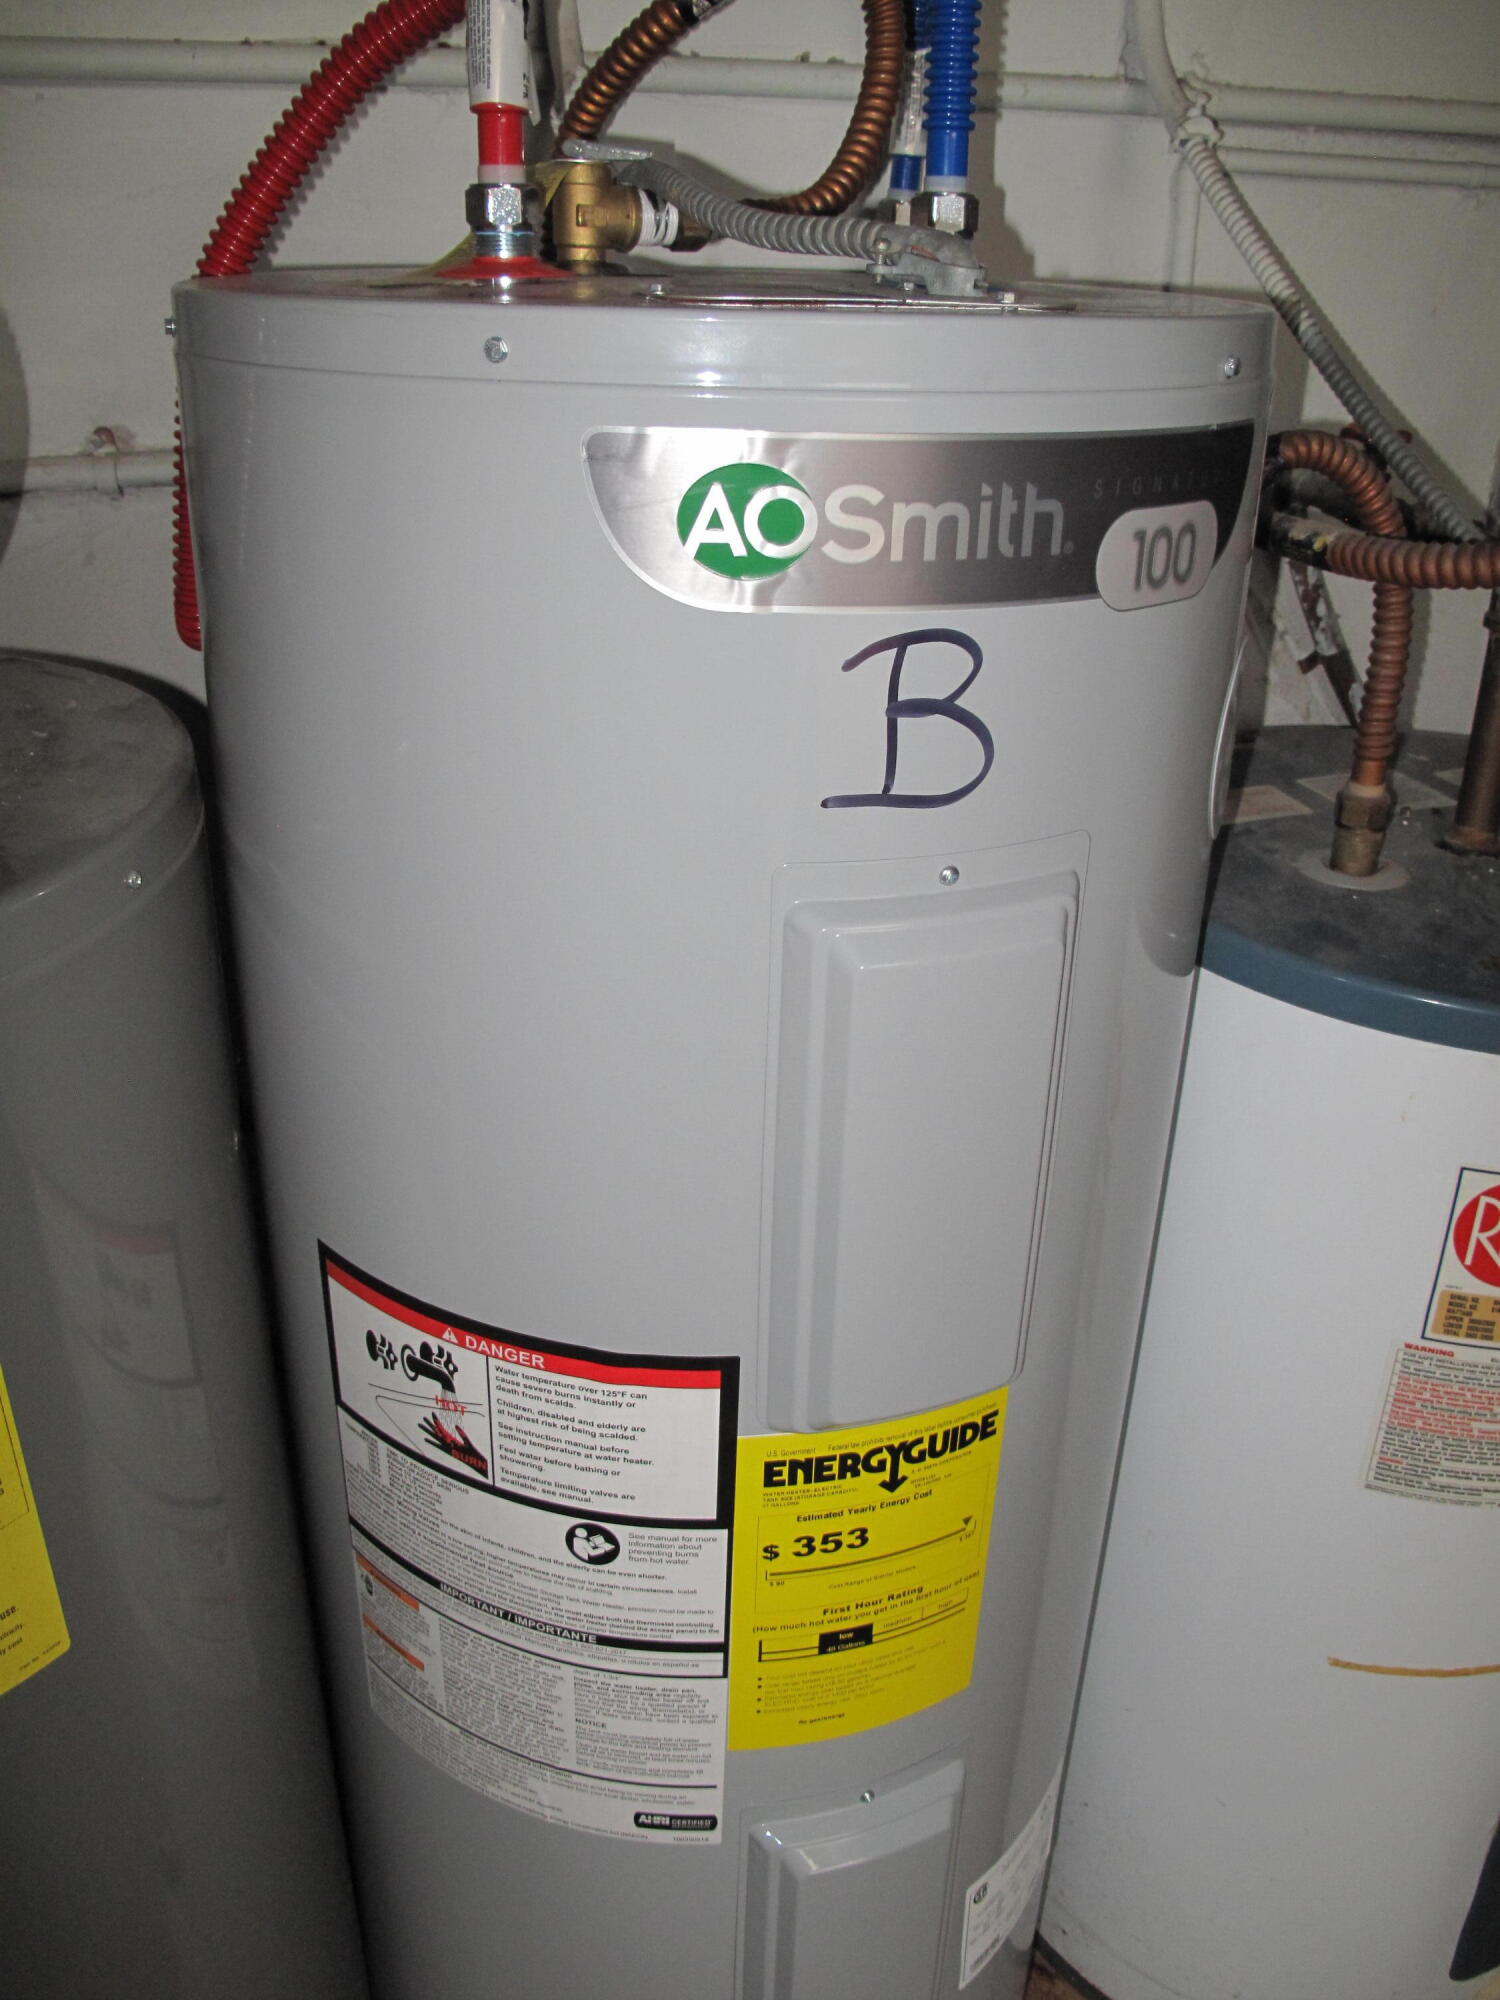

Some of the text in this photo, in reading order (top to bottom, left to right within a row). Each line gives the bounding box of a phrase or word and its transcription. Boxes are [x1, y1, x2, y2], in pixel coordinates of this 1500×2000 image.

[1133, 523, 1197, 594] 100
[820, 628, 994, 808] B
[465, 1333, 546, 1369] DANGER
[1404, 1342, 1454, 1358] WARNING
[495, 1365, 519, 1377] Water
[522, 1372, 575, 1390] temperature
[579, 1385, 602, 1395] over
[602, 1389, 627, 1398] 125°F
[496, 1377, 521, 1387] cause
[523, 1383, 552, 1395] severe
[555, 1388, 581, 1400] burns
[584, 1395, 624, 1408] instantly
[496, 1385, 576, 1409] death from scalds.
[435, 1394, 467, 1417] HOT
[497, 1398, 535, 1415] Children,
[538, 1409, 575, 1423] disabled
[578, 1418, 594, 1427] and
[597, 1421, 624, 1433] elderly
[498, 1421, 629, 1454] See instruction manual before
[507, 1410, 539, 1425] highest
[541, 1418, 557, 1428] risk
[572, 1425, 597, 1438] being
[599, 1430, 637, 1441] scalded.
[451, 1446, 488, 1470] BURN
[498, 1432, 527, 1445] setting
[529, 1440, 582, 1456] temperature
[595, 1454, 620, 1463] water
[623, 1457, 654, 1466] heater.
[499, 1444, 516, 1454] Feel
[519, 1452, 541, 1461] water
[544, 1456, 572, 1468] before
[574, 1463, 608, 1476] bathing
[500, 1454, 545, 1472] showering.
[764, 1409, 999, 1492] ENERGYGUIDE
[780, 1447, 816, 1457] Government
[828, 1443, 848, 1451] Federal
[500, 1467, 552, 1486] Temperature
[554, 1481, 587, 1495] limiting
[590, 1488, 618, 1500] valves
[501, 1476, 593, 1504] available, see manual.
[797, 1489, 933, 1523] Estimated Yearly Energy Cost
[628, 1532, 645, 1540] See
[648, 1533, 679, 1542] manual
[628, 1541, 675, 1550] information
[763, 1527, 869, 1561] $ 353
[539, 1555, 552, 1564] and
[566, 1561, 590, 1572] elderly
[619, 1571, 636, 1579] even
[628, 1549, 673, 1559] preventing
[628, 1556, 648, 1564] from
[439, 1583, 504, 1619] IMPORTANT
[514, 1615, 598, 1643] IMPORTANTE
[780, 1621, 807, 1632] much
[809, 1619, 824, 1628] hot
[827, 1616, 852, 1627] water
[855, 1610, 873, 1619] you
[874, 1605, 887, 1616] get
[900, 1598, 913, 1607] the
[916, 1590, 932, 1603] first
[934, 1583, 951, 1596] hour
[823, 1585, 924, 1616] First Hour Rating
[839, 1631, 854, 1640] low
[575, 1718, 607, 1729] NOTICE
